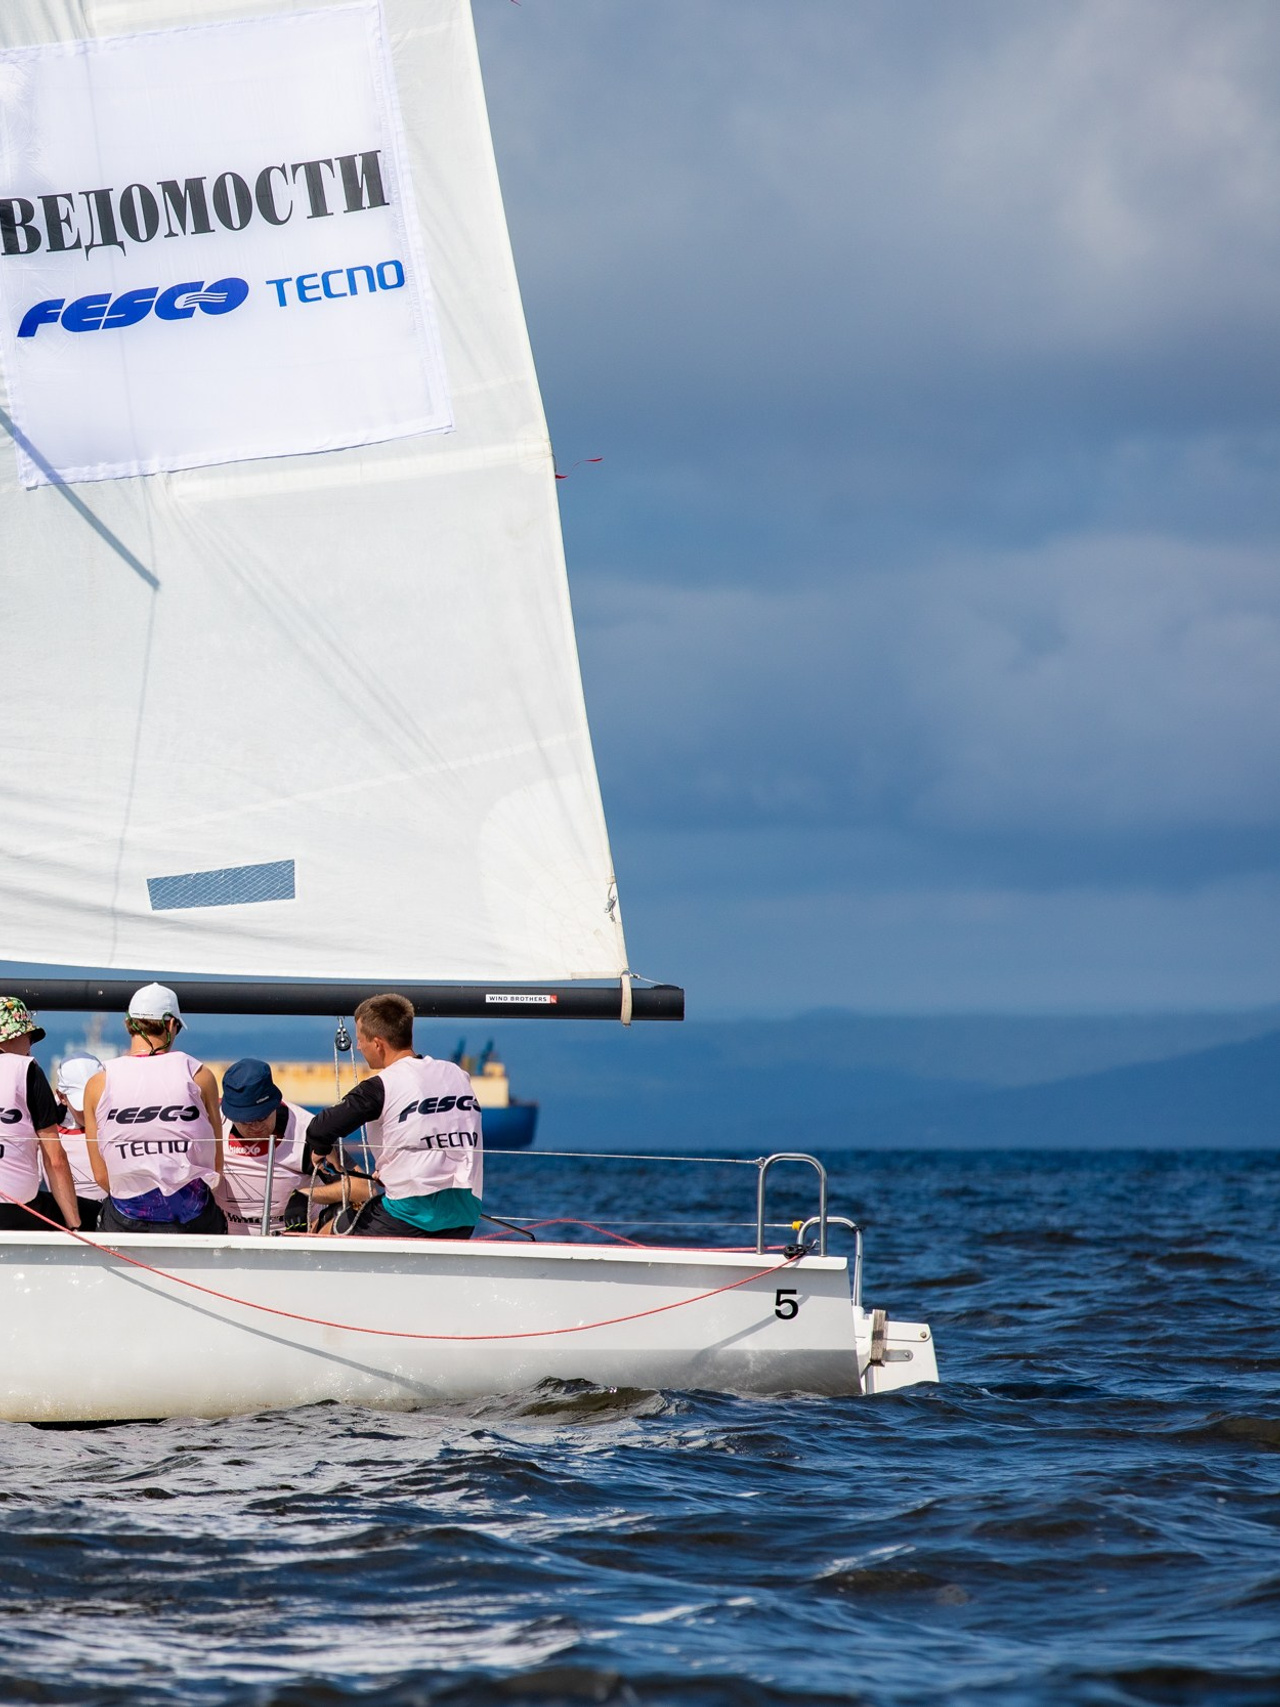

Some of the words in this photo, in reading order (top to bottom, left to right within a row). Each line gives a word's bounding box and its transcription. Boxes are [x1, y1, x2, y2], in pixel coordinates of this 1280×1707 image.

[17, 277, 250, 338] FESCO
[266, 259, 406, 307] TECNO
[510, 995, 548, 1003] BROTHERS
[774, 1289, 799, 1320] 5
